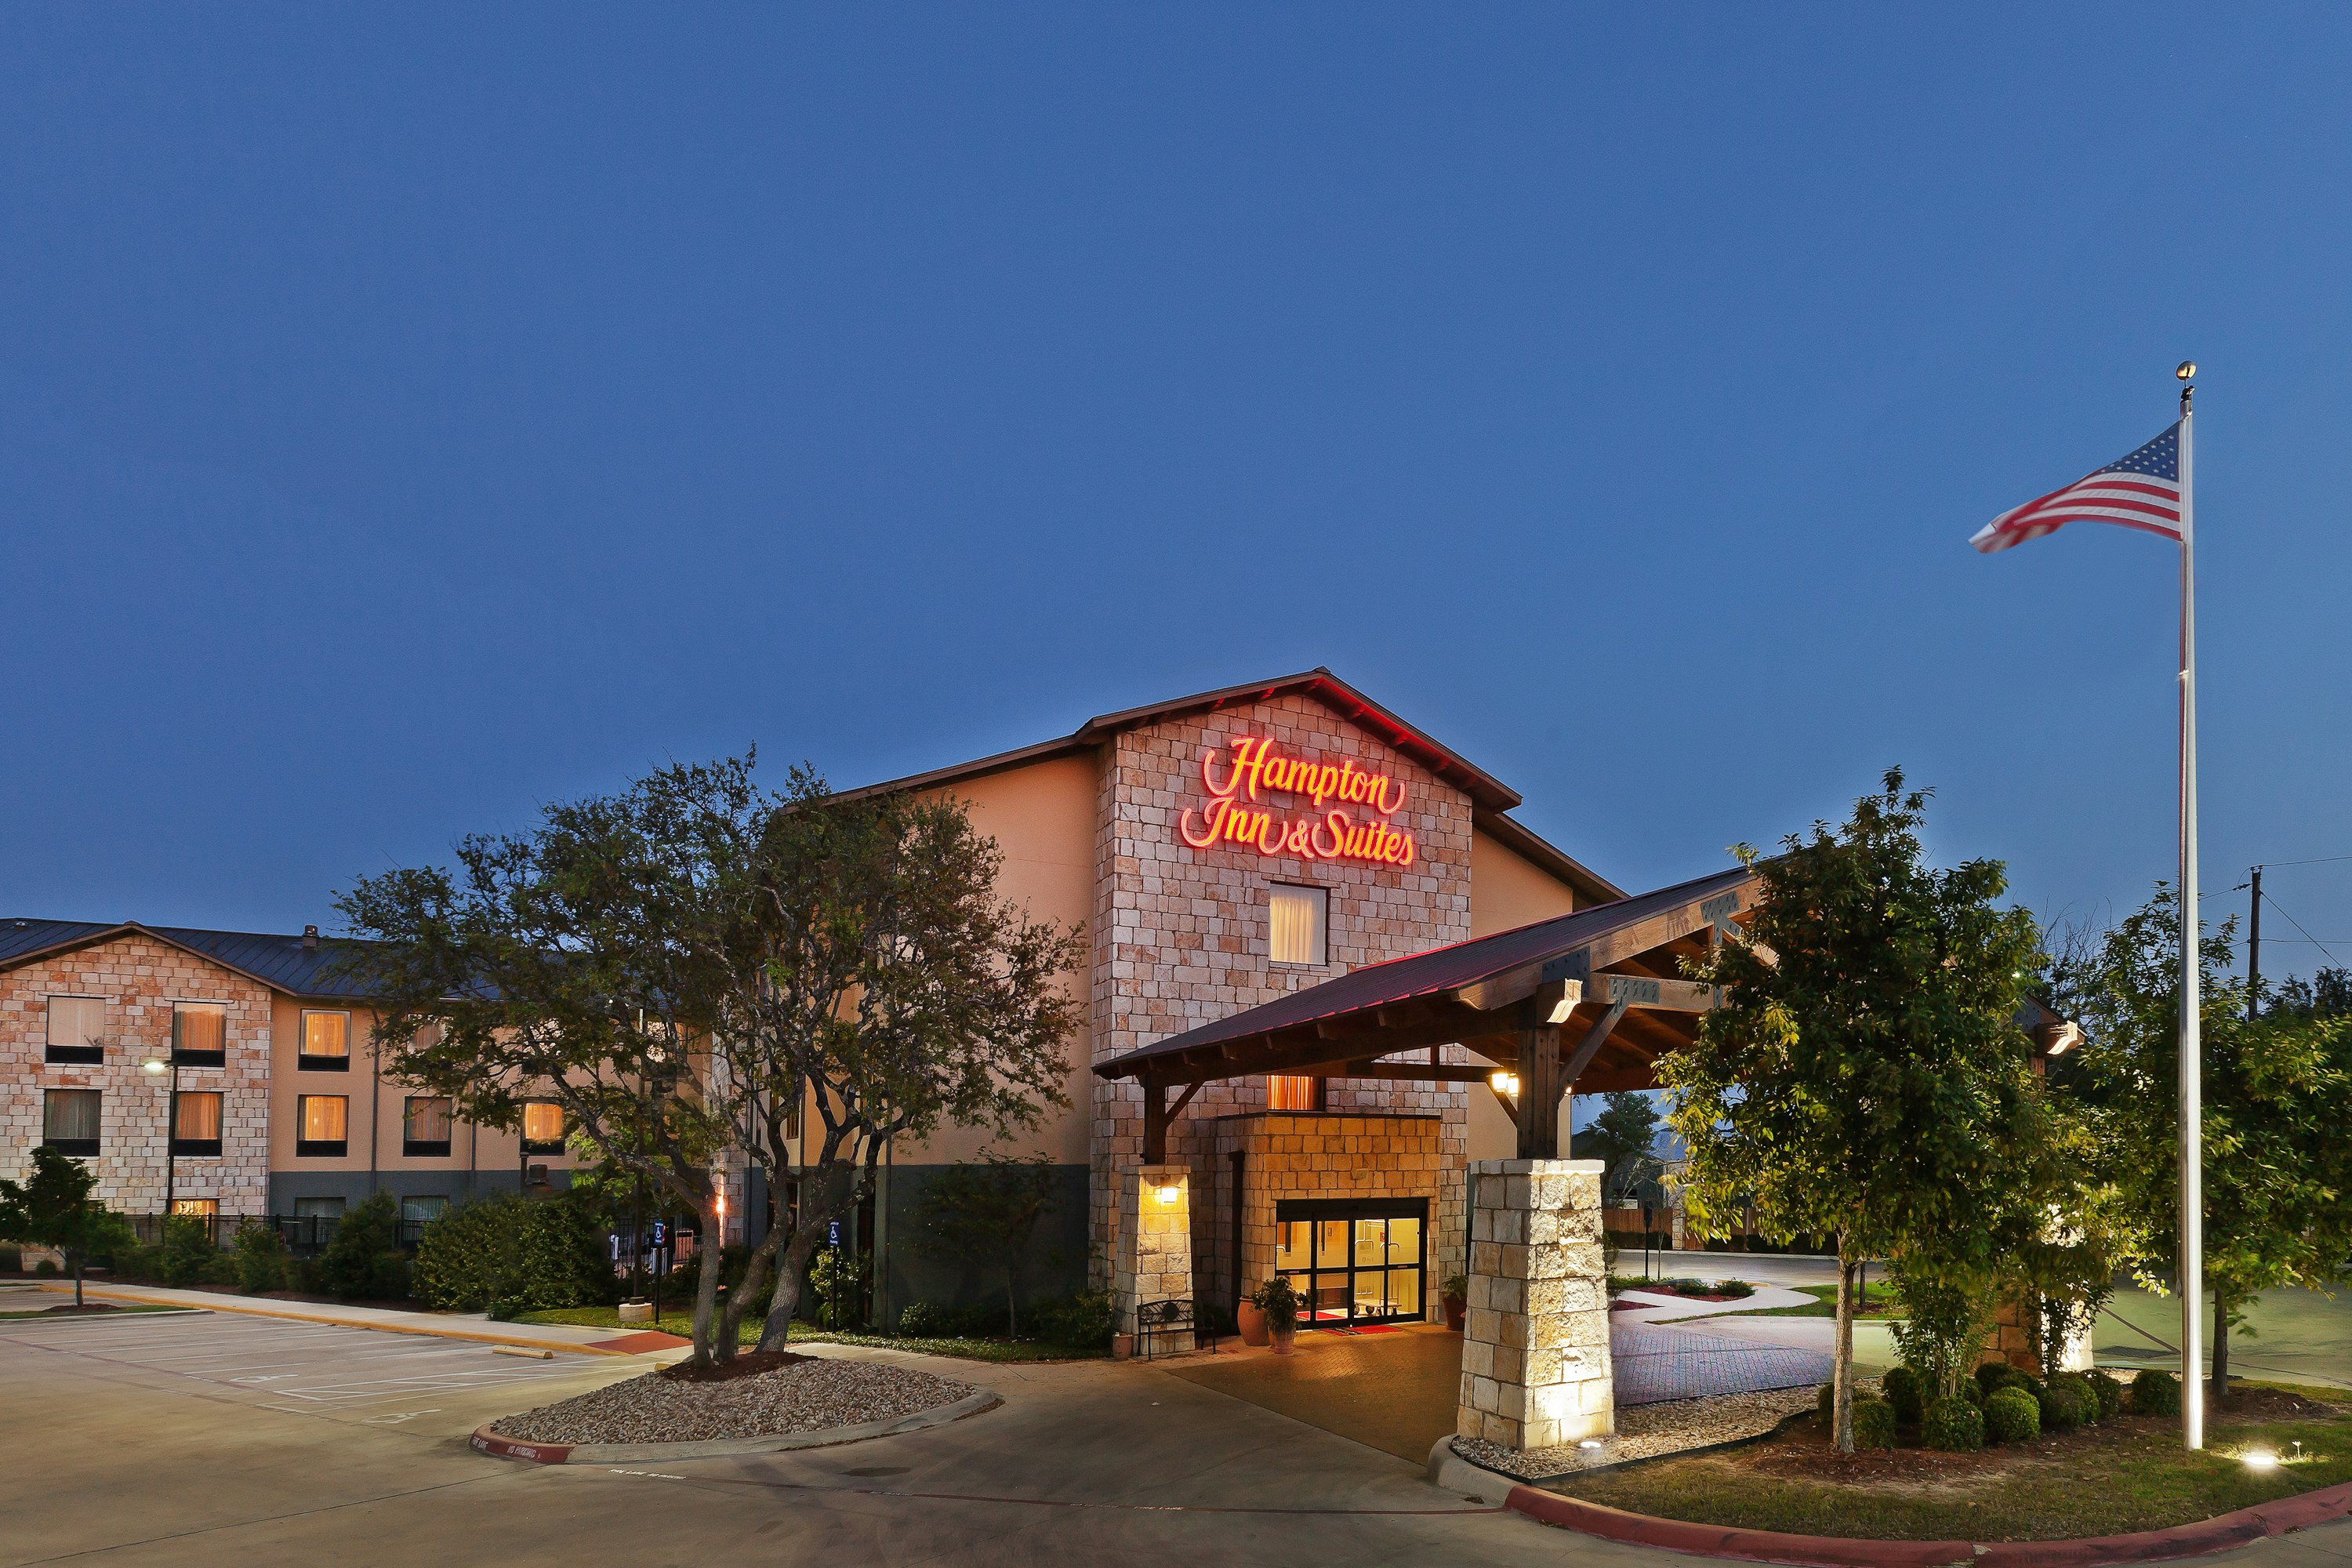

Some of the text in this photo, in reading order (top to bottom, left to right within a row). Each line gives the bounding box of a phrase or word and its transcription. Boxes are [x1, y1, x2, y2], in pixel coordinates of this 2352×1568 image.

[1203, 737, 1406, 815] Hampton
[1181, 797, 1414, 866] Inn & Suites
[506, 1445, 536, 1458] NO PARKING
